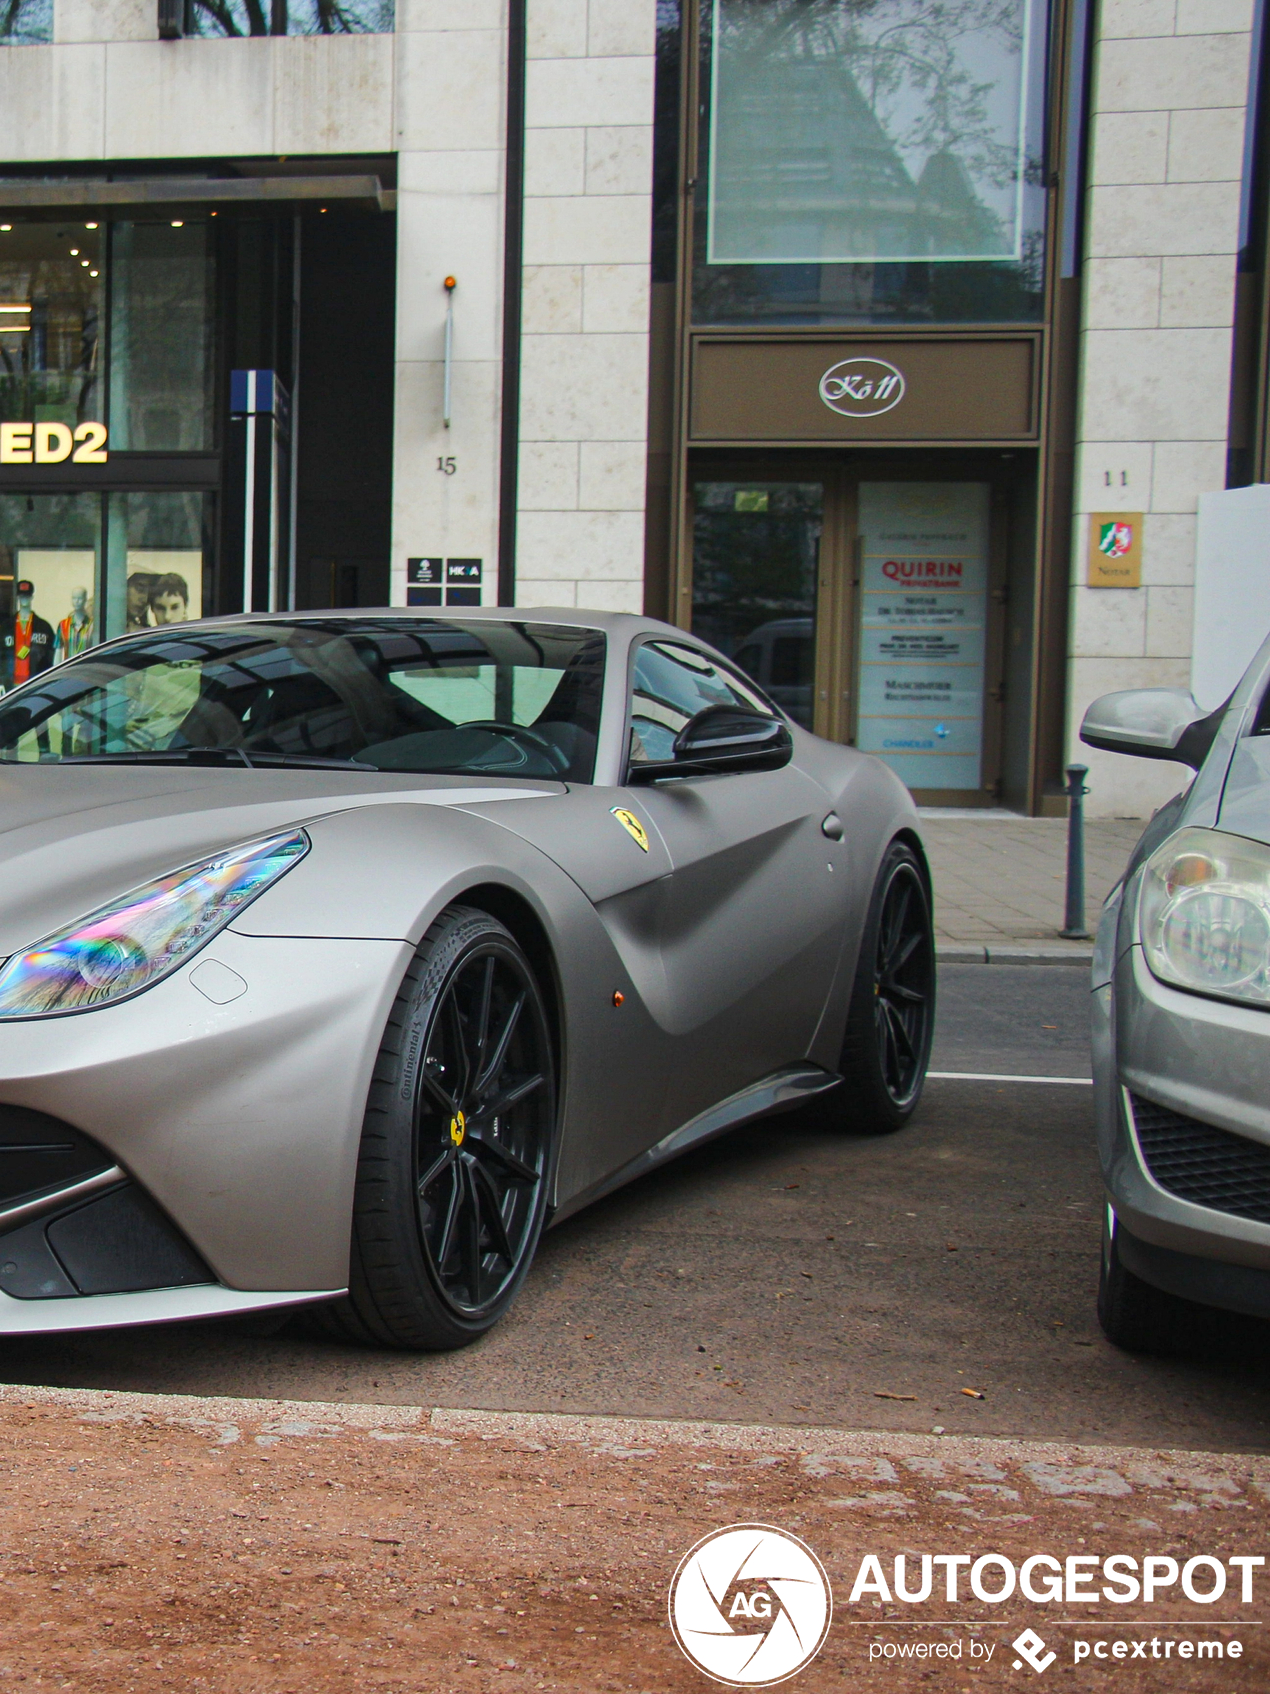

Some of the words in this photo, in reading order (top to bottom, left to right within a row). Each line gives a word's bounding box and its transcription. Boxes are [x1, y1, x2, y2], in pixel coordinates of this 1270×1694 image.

[436, 456, 457, 476] 15
[1103, 470, 1128, 487] 11
[882, 561, 963, 581] QUIRIN
[401, 1029, 421, 1101] Continental
